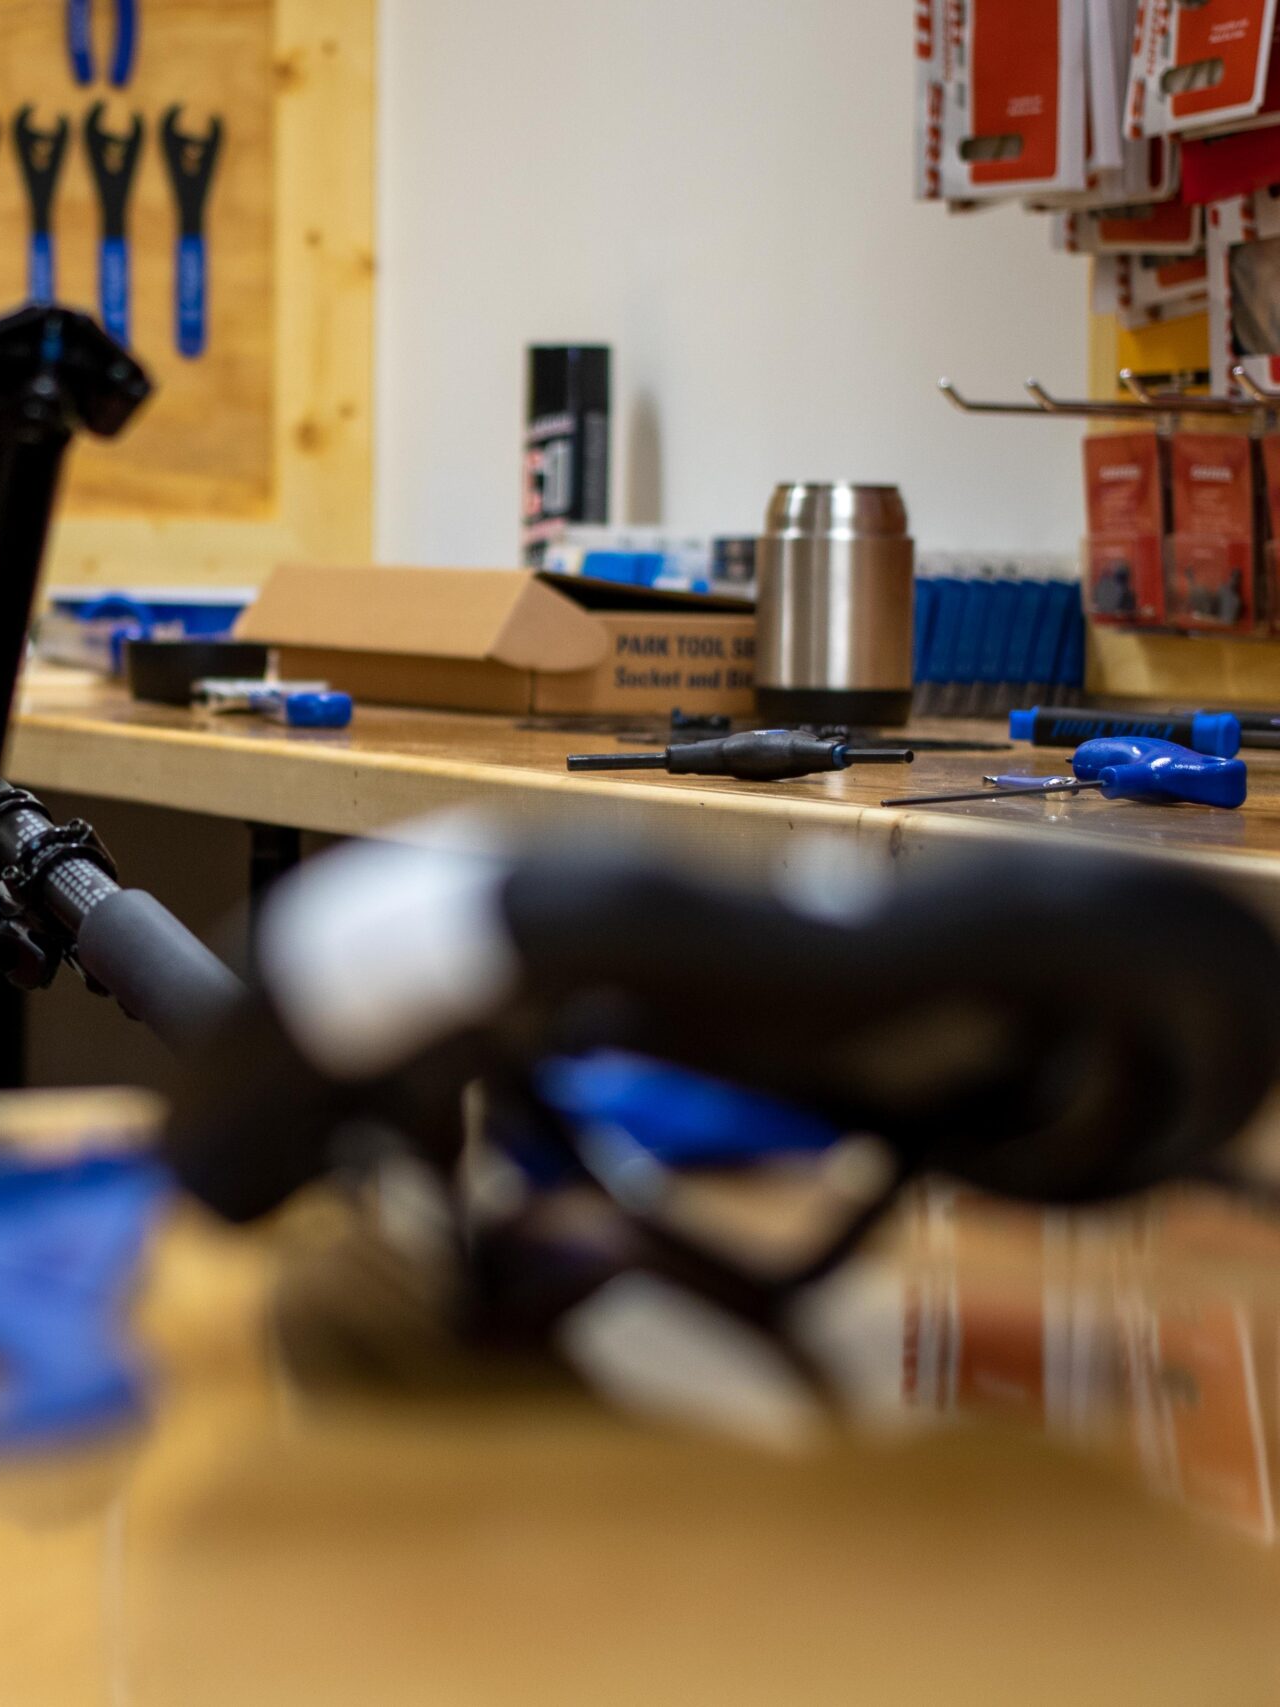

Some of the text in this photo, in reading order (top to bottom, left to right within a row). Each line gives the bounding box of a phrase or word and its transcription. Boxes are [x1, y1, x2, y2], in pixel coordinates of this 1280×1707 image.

[616, 635, 668, 657] PARK
[677, 635, 723, 657] TOOL
[615, 666, 681, 688] Socket
[686, 668, 721, 689] and
